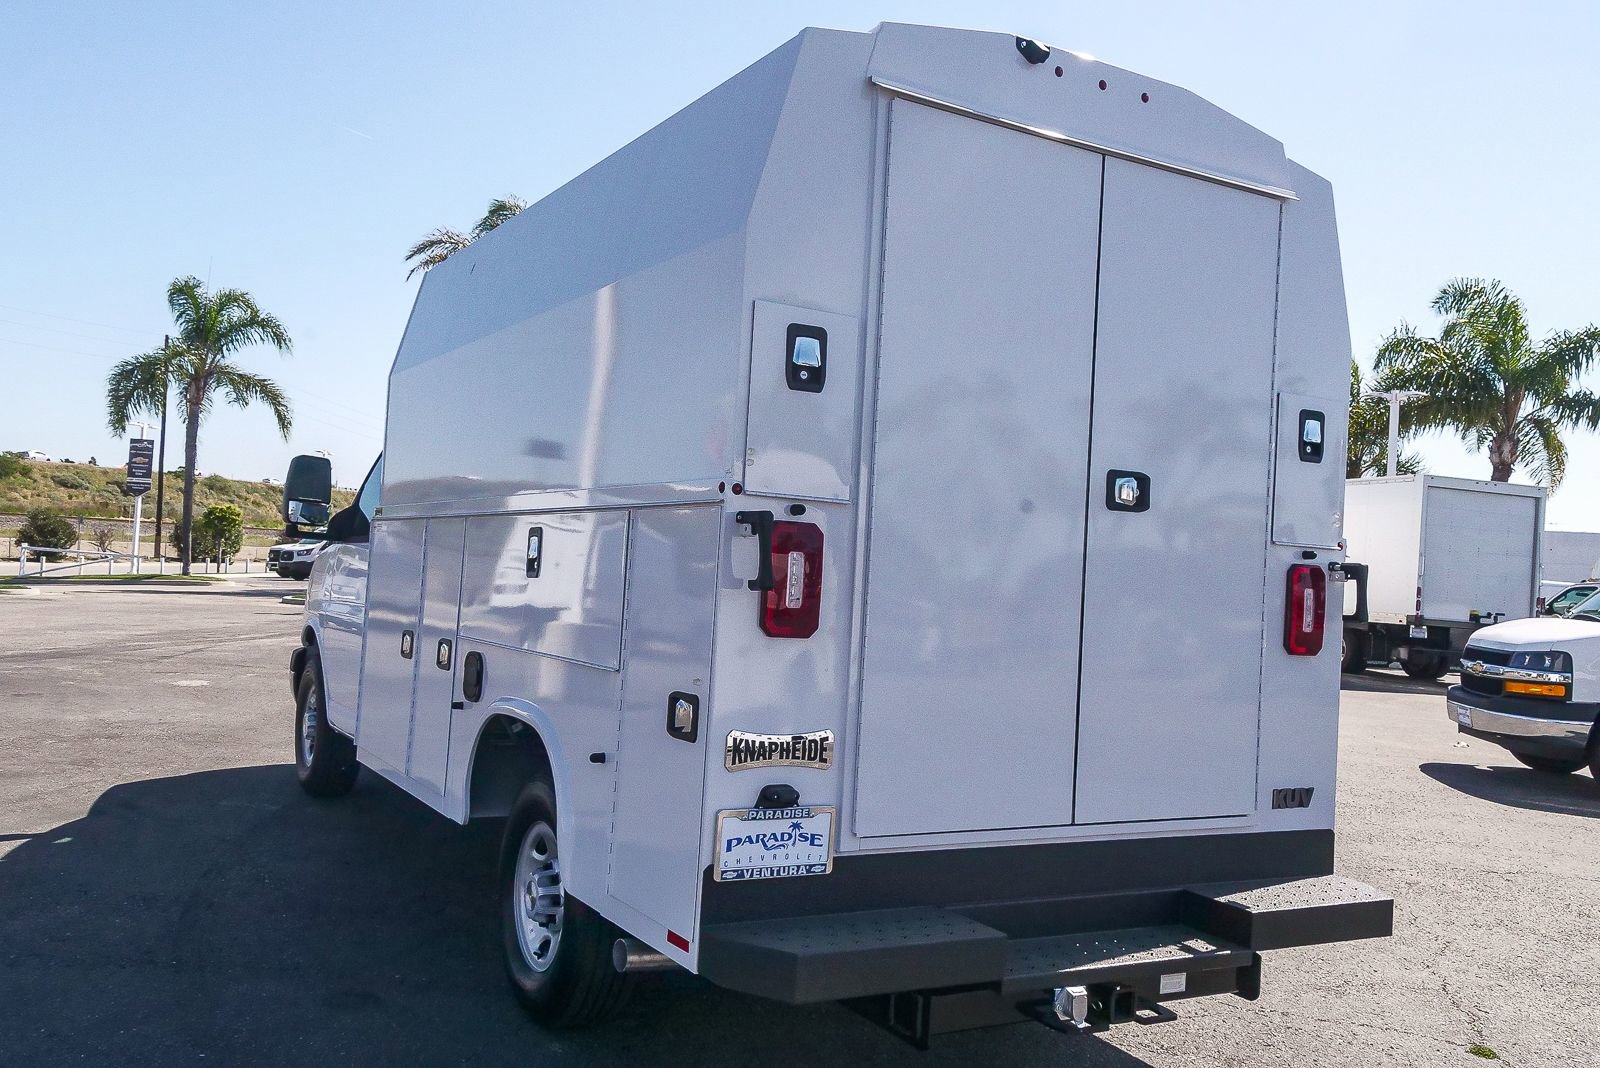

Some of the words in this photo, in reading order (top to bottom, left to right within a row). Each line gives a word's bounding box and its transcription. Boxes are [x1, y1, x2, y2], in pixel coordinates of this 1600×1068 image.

[731, 736, 830, 766] KNAPHEIDE
[1272, 787, 1315, 809] KUV
[749, 808, 810, 820] PARADISE
[725, 821, 824, 853] PARADISE
[723, 853, 823, 867] CHEVROLET
[743, 865, 807, 879] VENTURA
